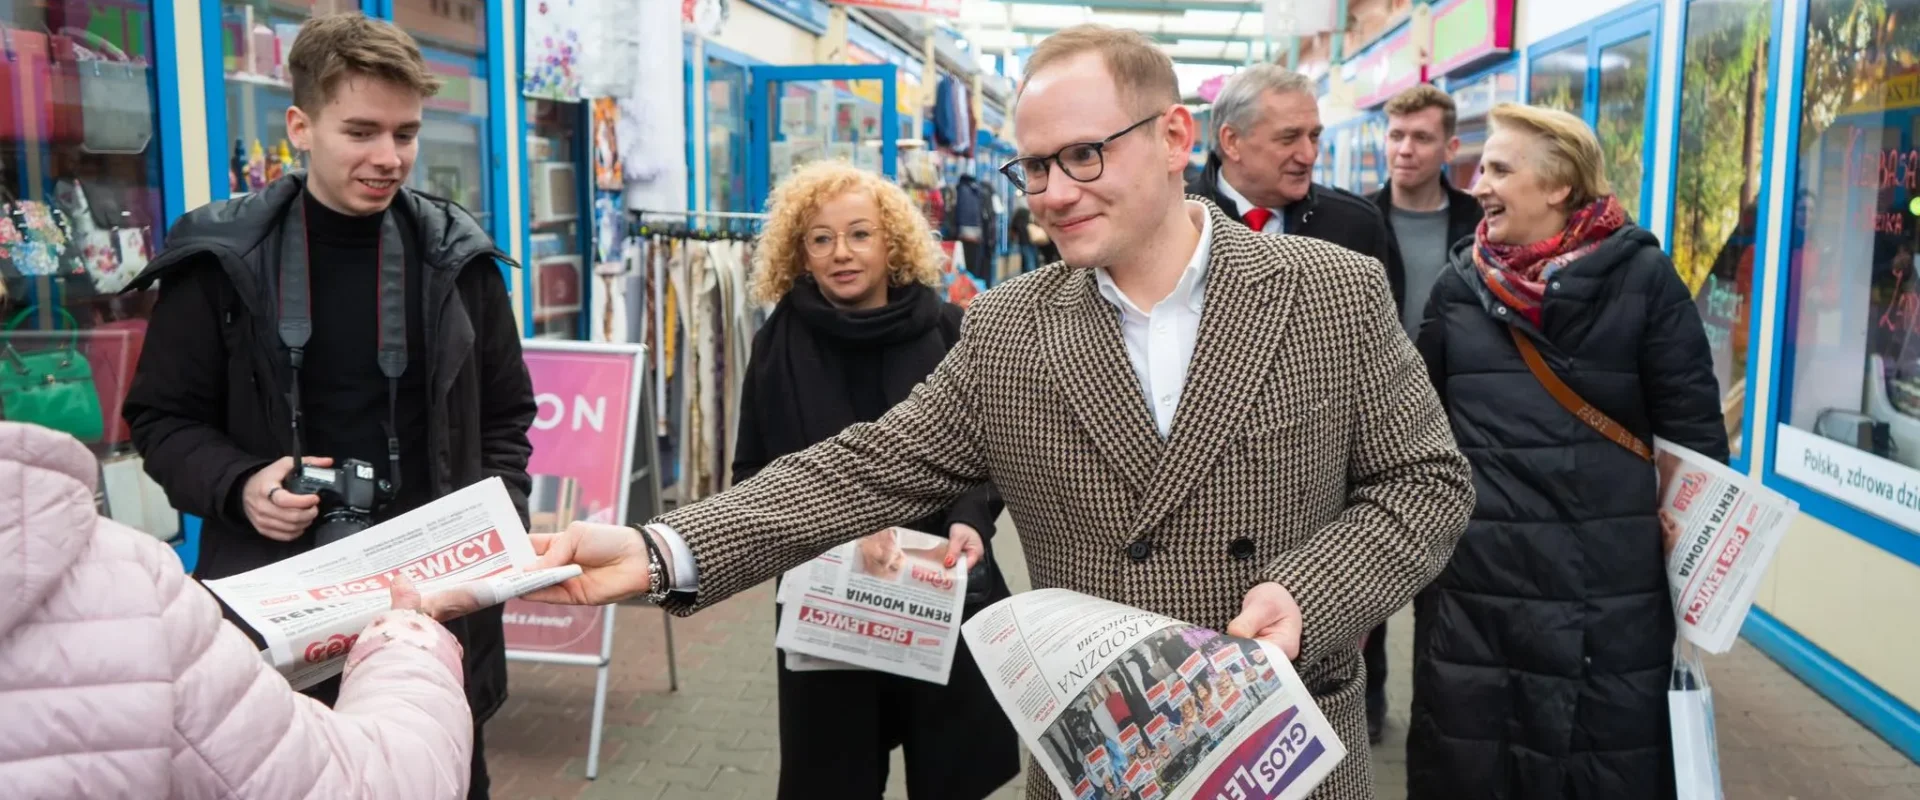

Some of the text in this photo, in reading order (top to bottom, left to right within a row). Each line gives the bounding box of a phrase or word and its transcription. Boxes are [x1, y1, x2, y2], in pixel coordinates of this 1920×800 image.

[1803, 448, 1920, 514] Polska, zdrowa dzi
[1709, 484, 1740, 524] RENTA
[386, 532, 493, 583] EWICY
[1678, 525, 1716, 578] WDOWIA
[845, 587, 905, 612] WDOWIA
[908, 602, 953, 623] RENTA
[1687, 560, 1728, 626] LEWICY
[802, 607, 870, 635] LEWICY
[871, 624, 908, 644] głos
[1057, 622, 1141, 694] RODZINA
[1259, 722, 1307, 783] GŁOS
[1214, 765, 1257, 800] LE
